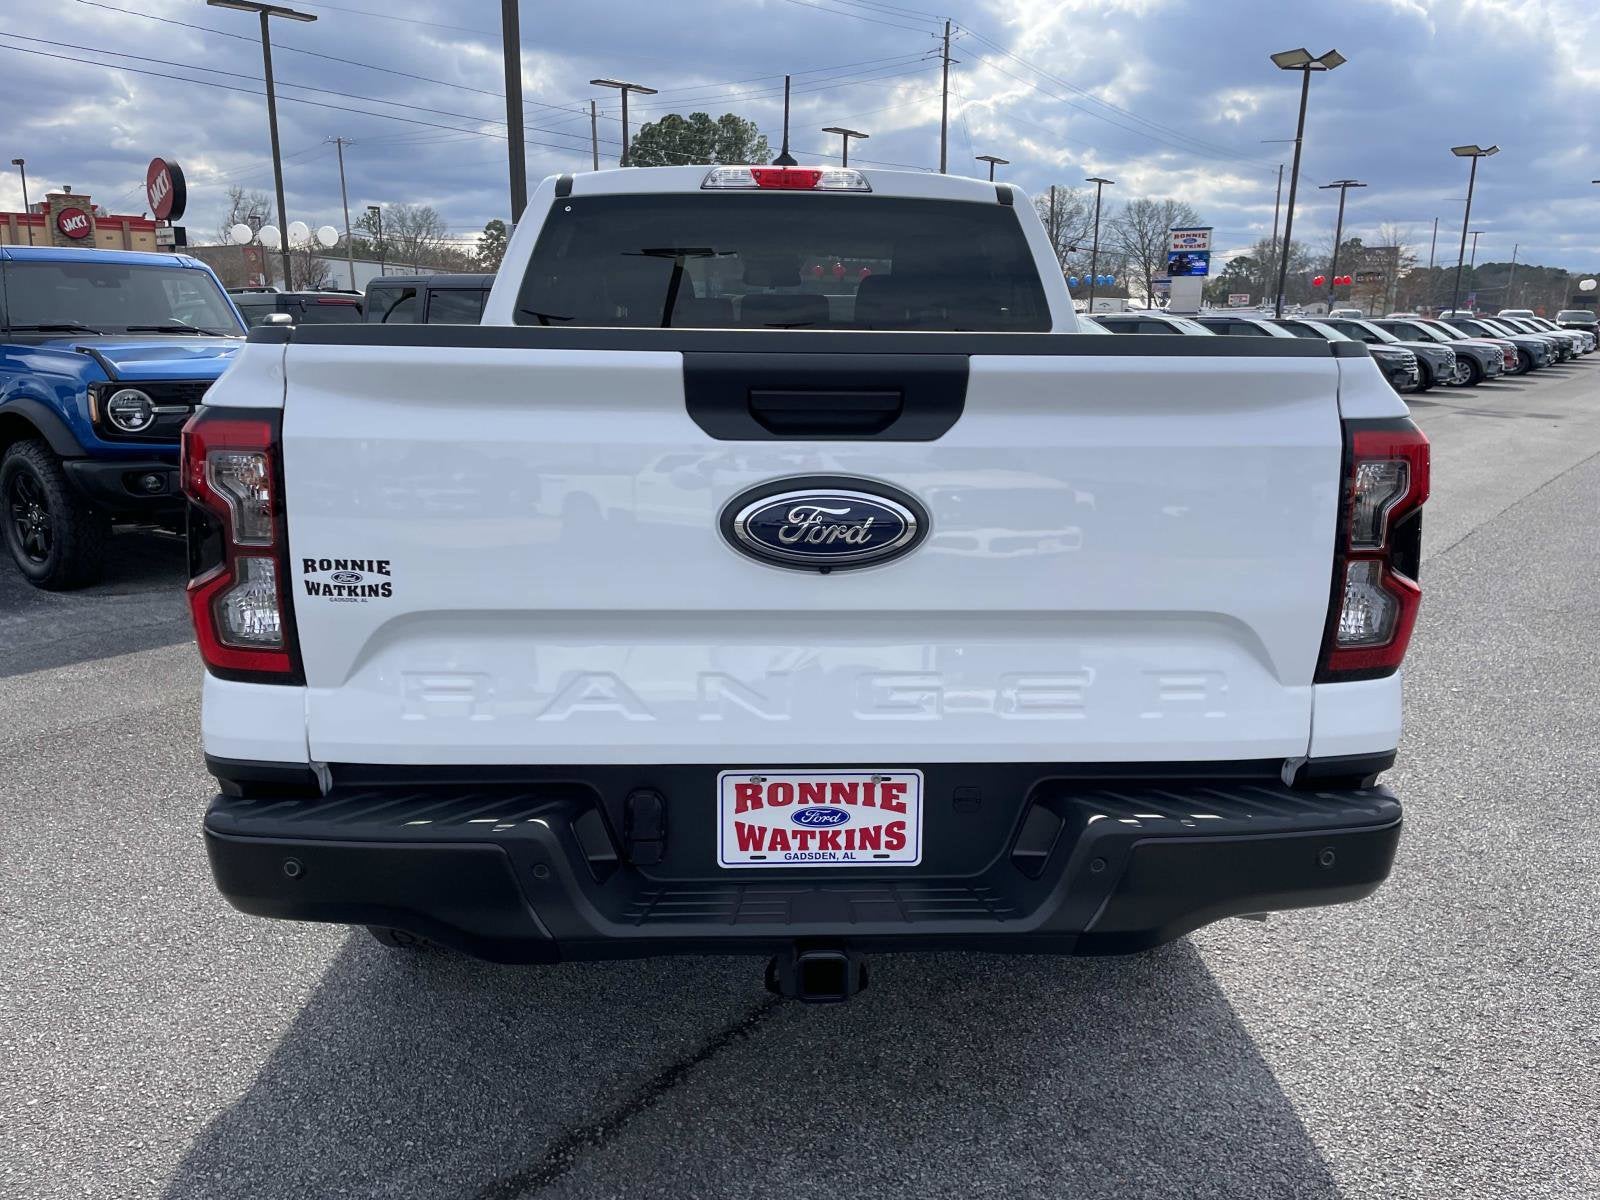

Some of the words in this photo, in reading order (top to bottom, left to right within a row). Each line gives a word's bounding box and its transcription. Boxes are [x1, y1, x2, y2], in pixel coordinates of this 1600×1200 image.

[1173, 232, 1208, 240] RONNIE
[778, 505, 875, 545] Ford
[302, 558, 391, 576] RONNIE
[304, 579, 393, 598] WATKINS
[400, 670, 1230, 722] RANGER
[734, 782, 908, 815] RONNIE
[800, 809, 842, 824] Ford
[734, 820, 907, 852] WATKINS
[784, 852, 840, 861] GADSDEN,
[842, 851, 857, 860] AL
